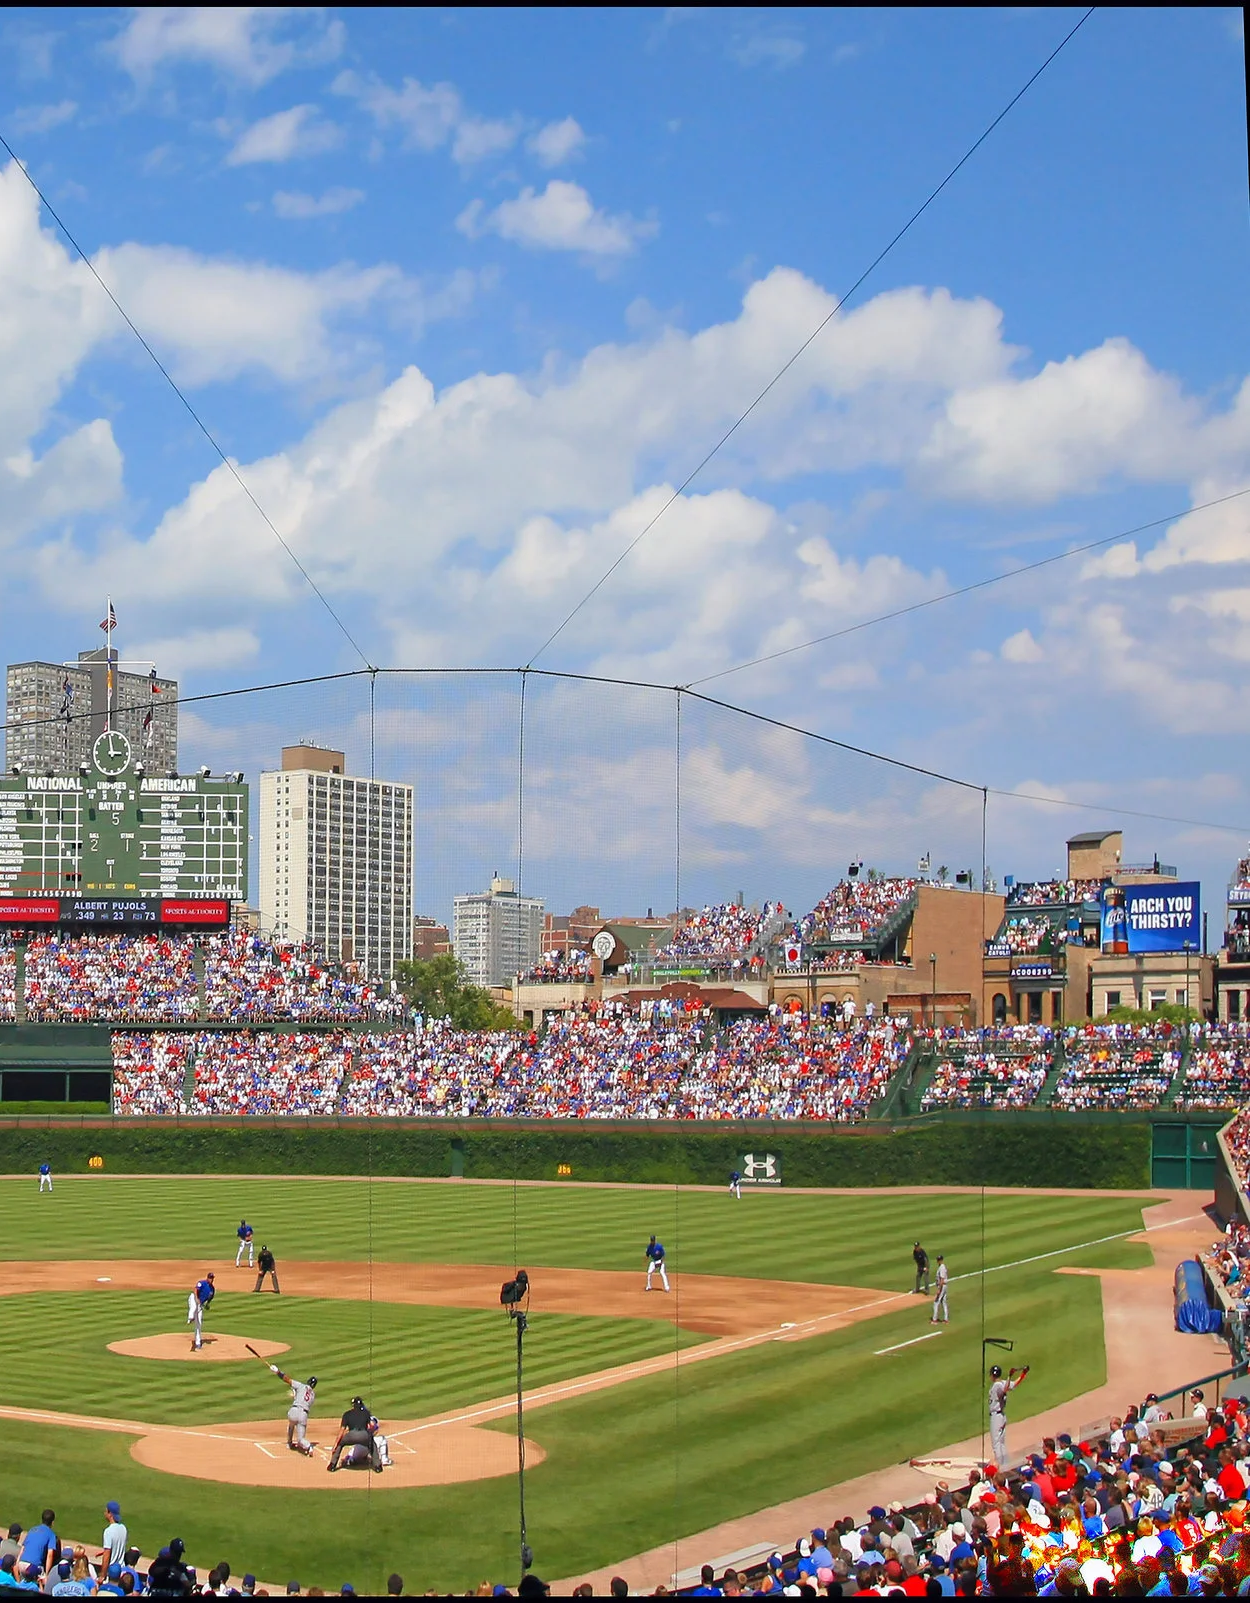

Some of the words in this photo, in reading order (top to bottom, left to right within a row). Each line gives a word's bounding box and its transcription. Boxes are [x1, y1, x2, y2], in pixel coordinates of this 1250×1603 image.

[27, 777, 83, 790] NATIONAL
[97, 782, 126, 790] UMPIRES
[140, 778, 196, 792] AMERICAN
[99, 802, 124, 810] BATTER
[112, 812, 120, 826] 5
[90, 839, 98, 852] 2
[126, 839, 129, 852] 1
[1131, 898, 1164, 914] ARCH
[1167, 896, 1192, 912] YOU
[76, 912, 95, 920] .349
[113, 912, 124, 920] 23
[144, 912, 156, 920] 73
[1131, 913, 1192, 930] THIRSTY?
[89, 1156, 102, 1166] 400
